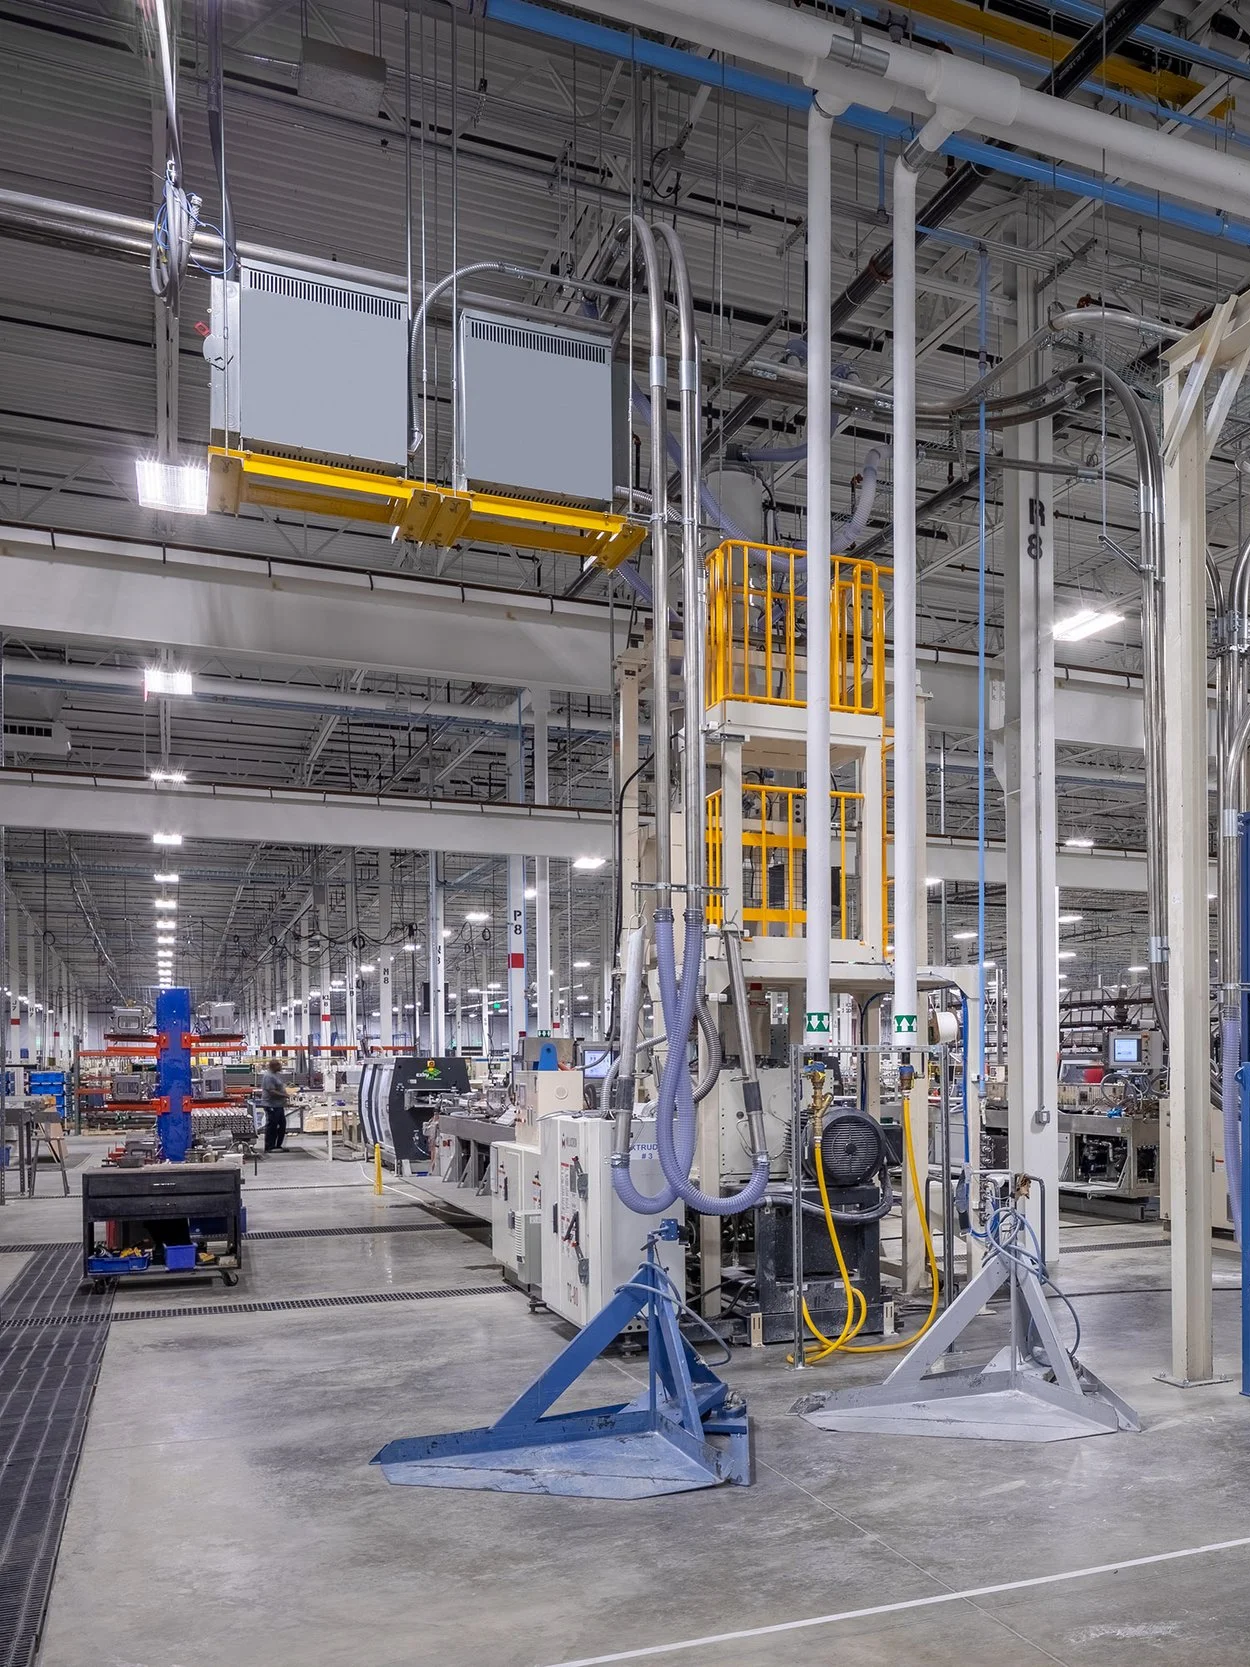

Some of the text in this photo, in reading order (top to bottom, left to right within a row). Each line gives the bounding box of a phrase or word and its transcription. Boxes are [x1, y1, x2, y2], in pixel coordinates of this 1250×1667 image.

[1029, 498, 1045, 526] R
[1027, 534, 1043, 560] 8
[514, 910, 522, 921] P
[514, 924, 522, 935] 8
